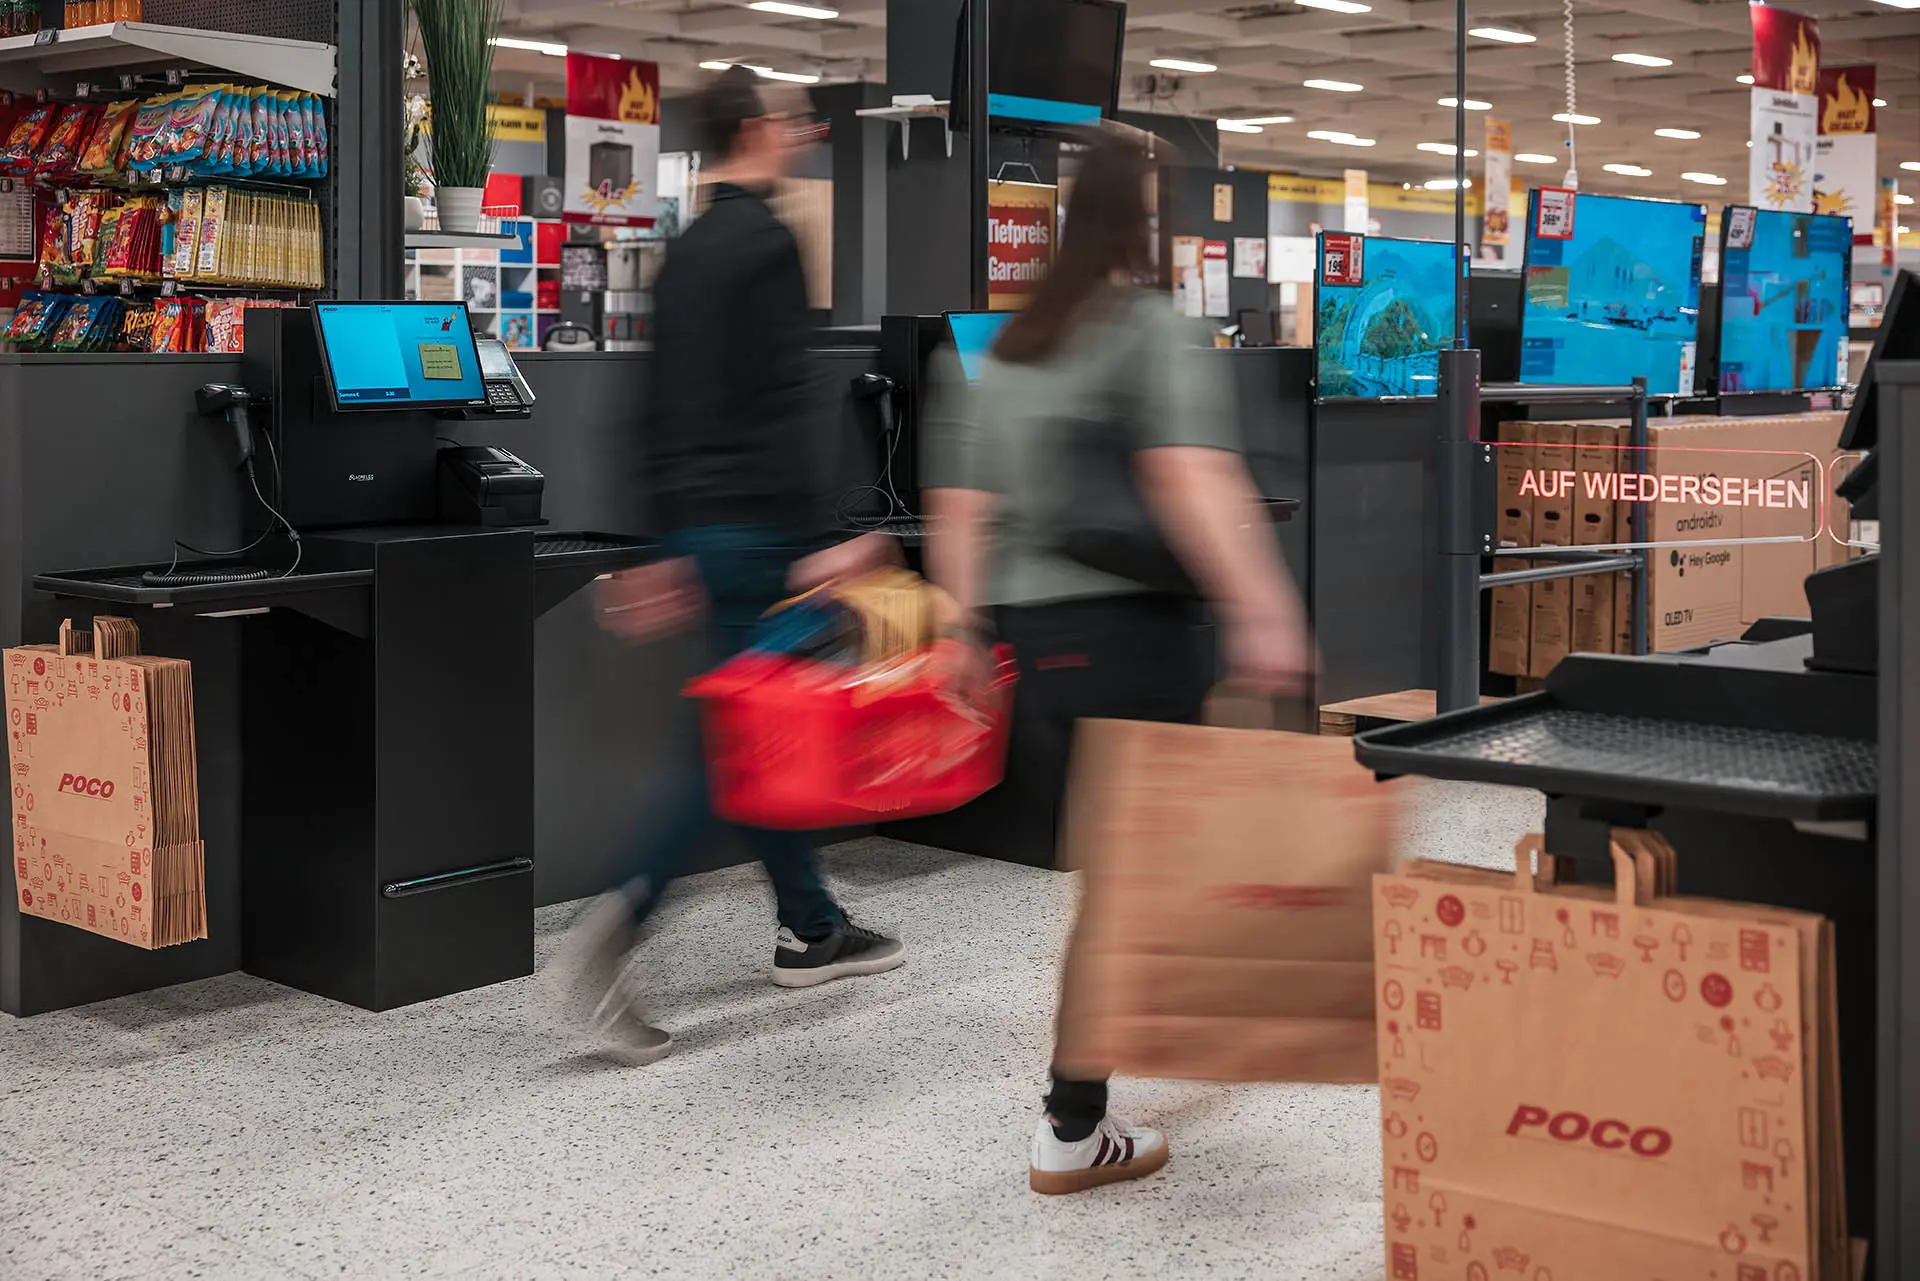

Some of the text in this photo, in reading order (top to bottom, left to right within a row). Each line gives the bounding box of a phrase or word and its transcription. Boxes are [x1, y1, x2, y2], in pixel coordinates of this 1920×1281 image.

[988, 218, 1049, 249] Tiefpreis
[1518, 468, 1577, 498] AUF
[1582, 471, 1809, 509] WIEDERSEHEN
[1689, 549, 1731, 568] Hey Google
[58, 773, 115, 799] POCO
[1505, 1104, 1673, 1157] POCO
